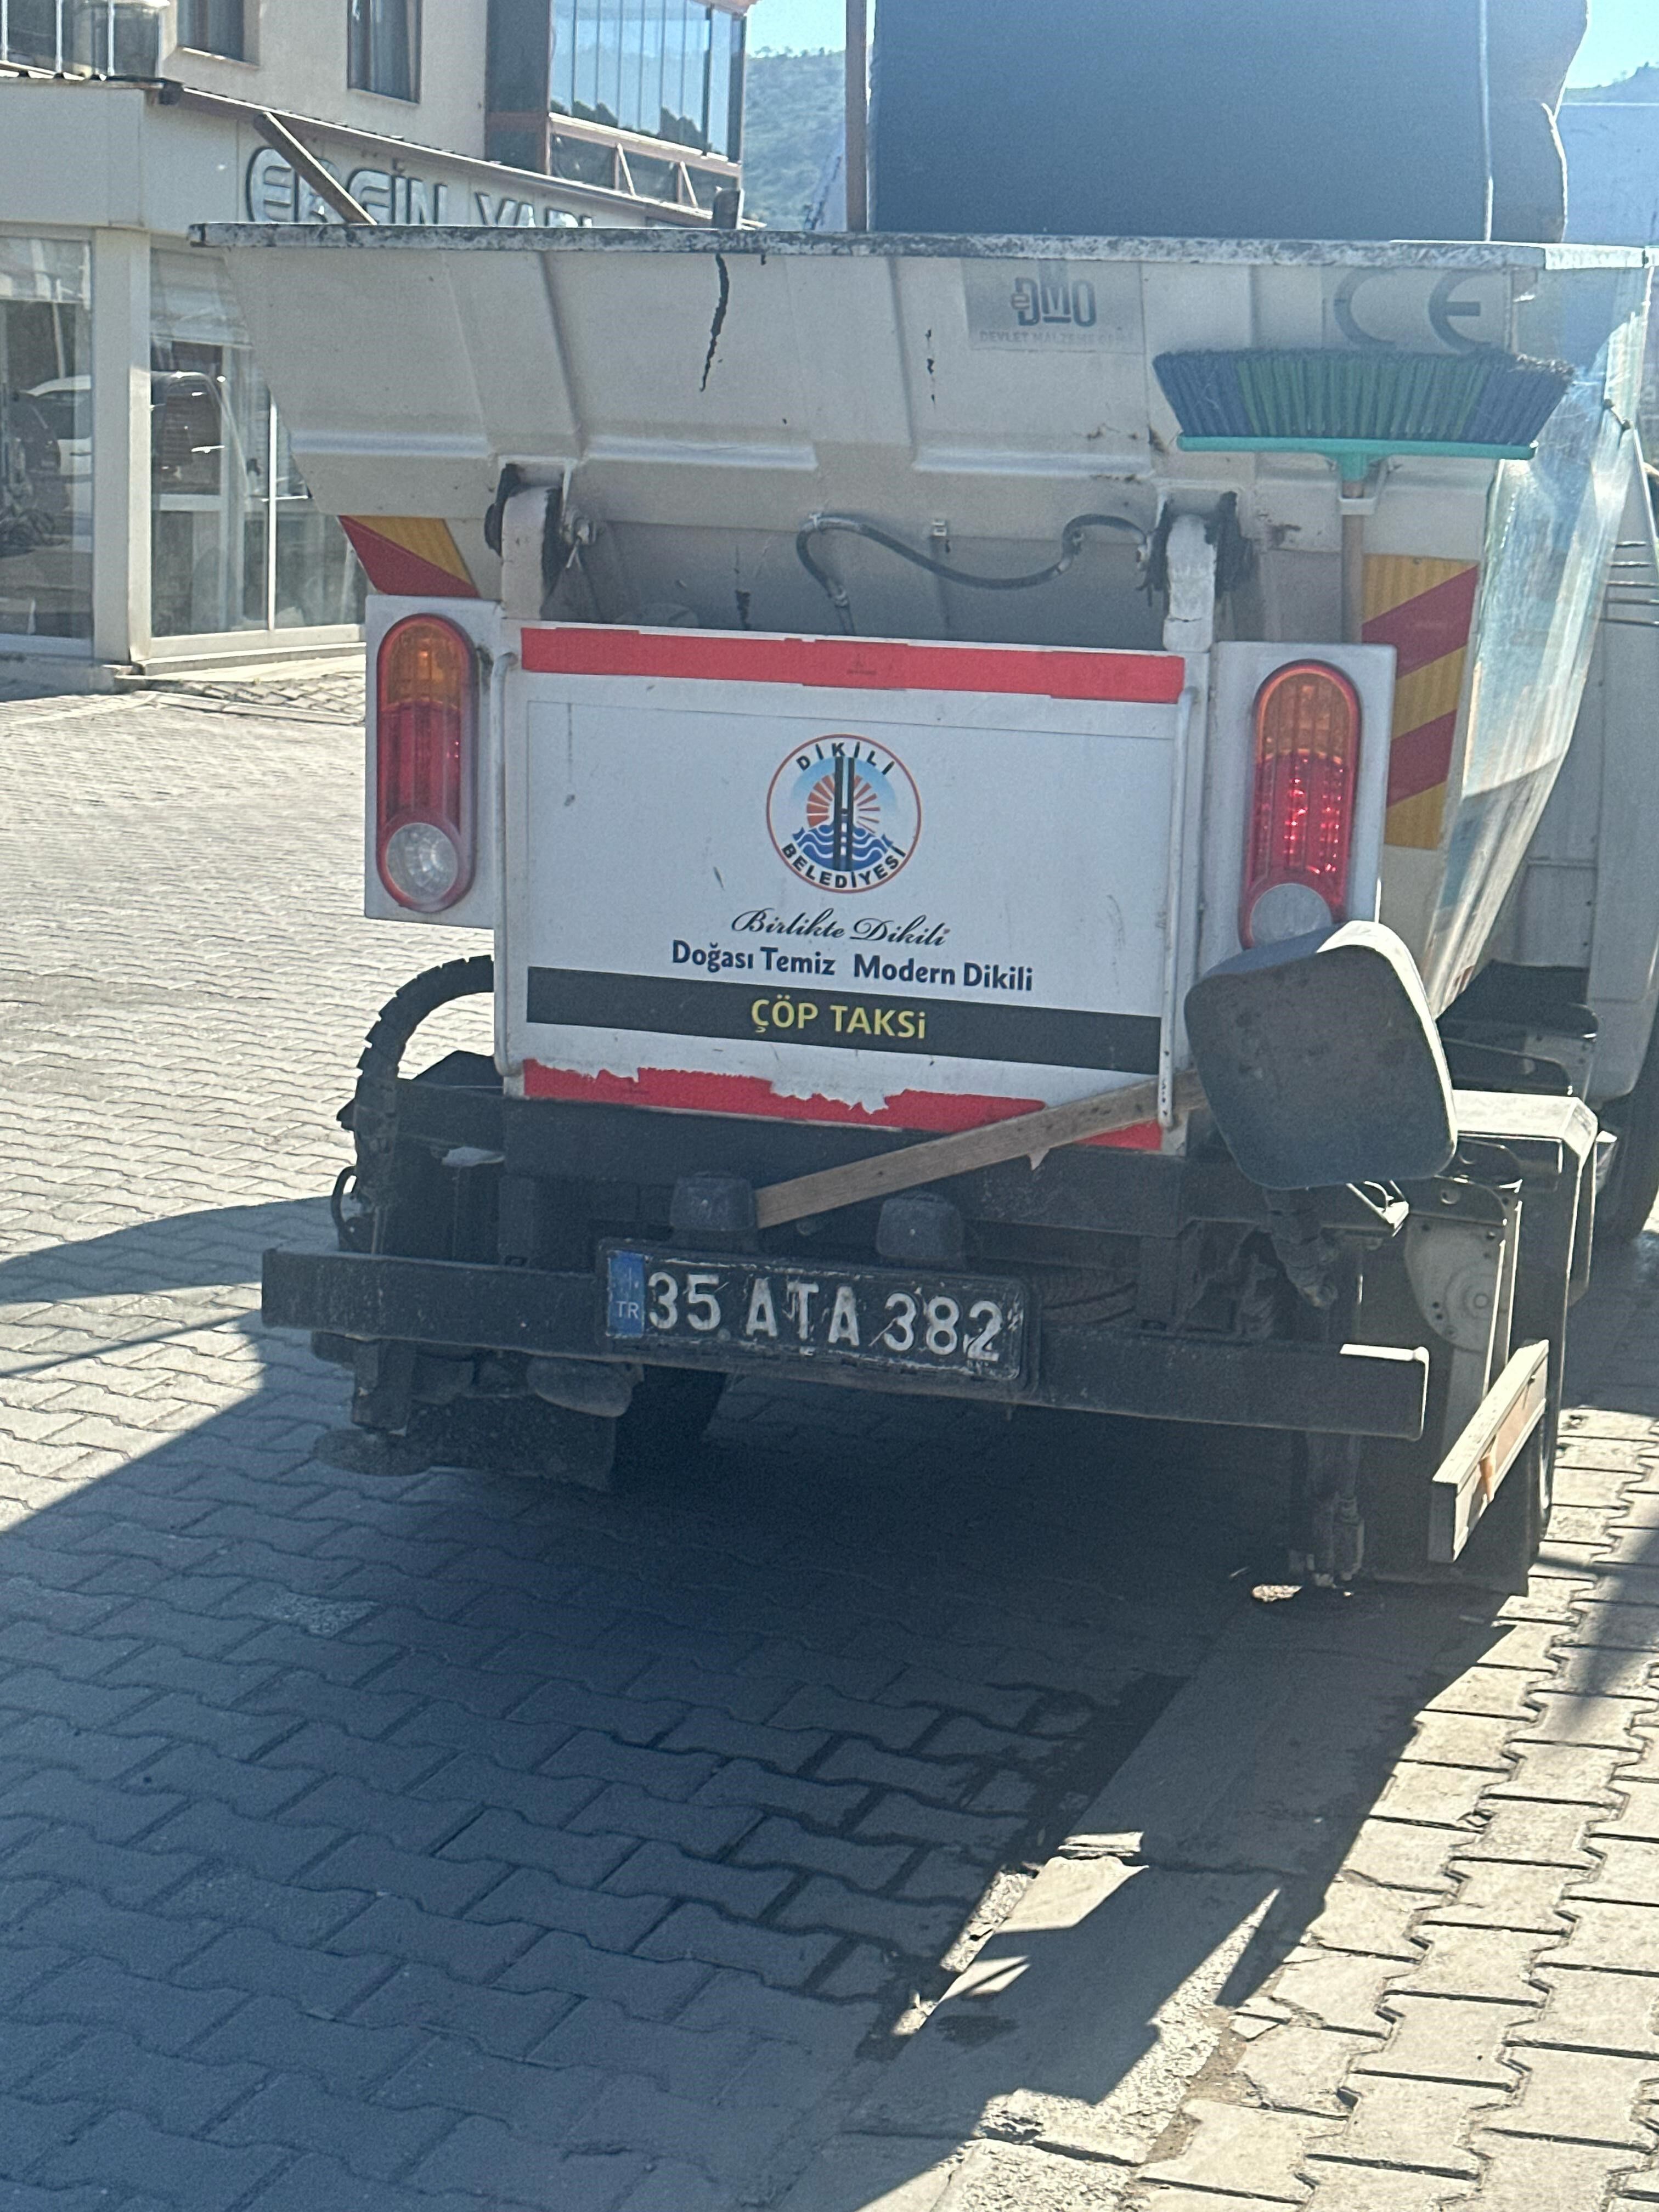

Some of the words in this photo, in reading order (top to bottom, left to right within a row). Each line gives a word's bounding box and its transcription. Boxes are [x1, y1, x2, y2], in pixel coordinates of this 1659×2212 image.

[731, 907, 844, 938] Birlikte
[850, 915, 950, 946] Dikili
[673, 939, 754, 973] Doğası
[760, 946, 836, 975] Temiz
[854, 953, 955, 985] Modern
[963, 962, 1032, 991] Dikili
[752, 994, 819, 1033] ÇÖP
[616, 1301, 639, 1319] TR
[648, 1272, 721, 1330] 35
[746, 1278, 860, 1346] ATA
[883, 1293, 1003, 1362] 382
